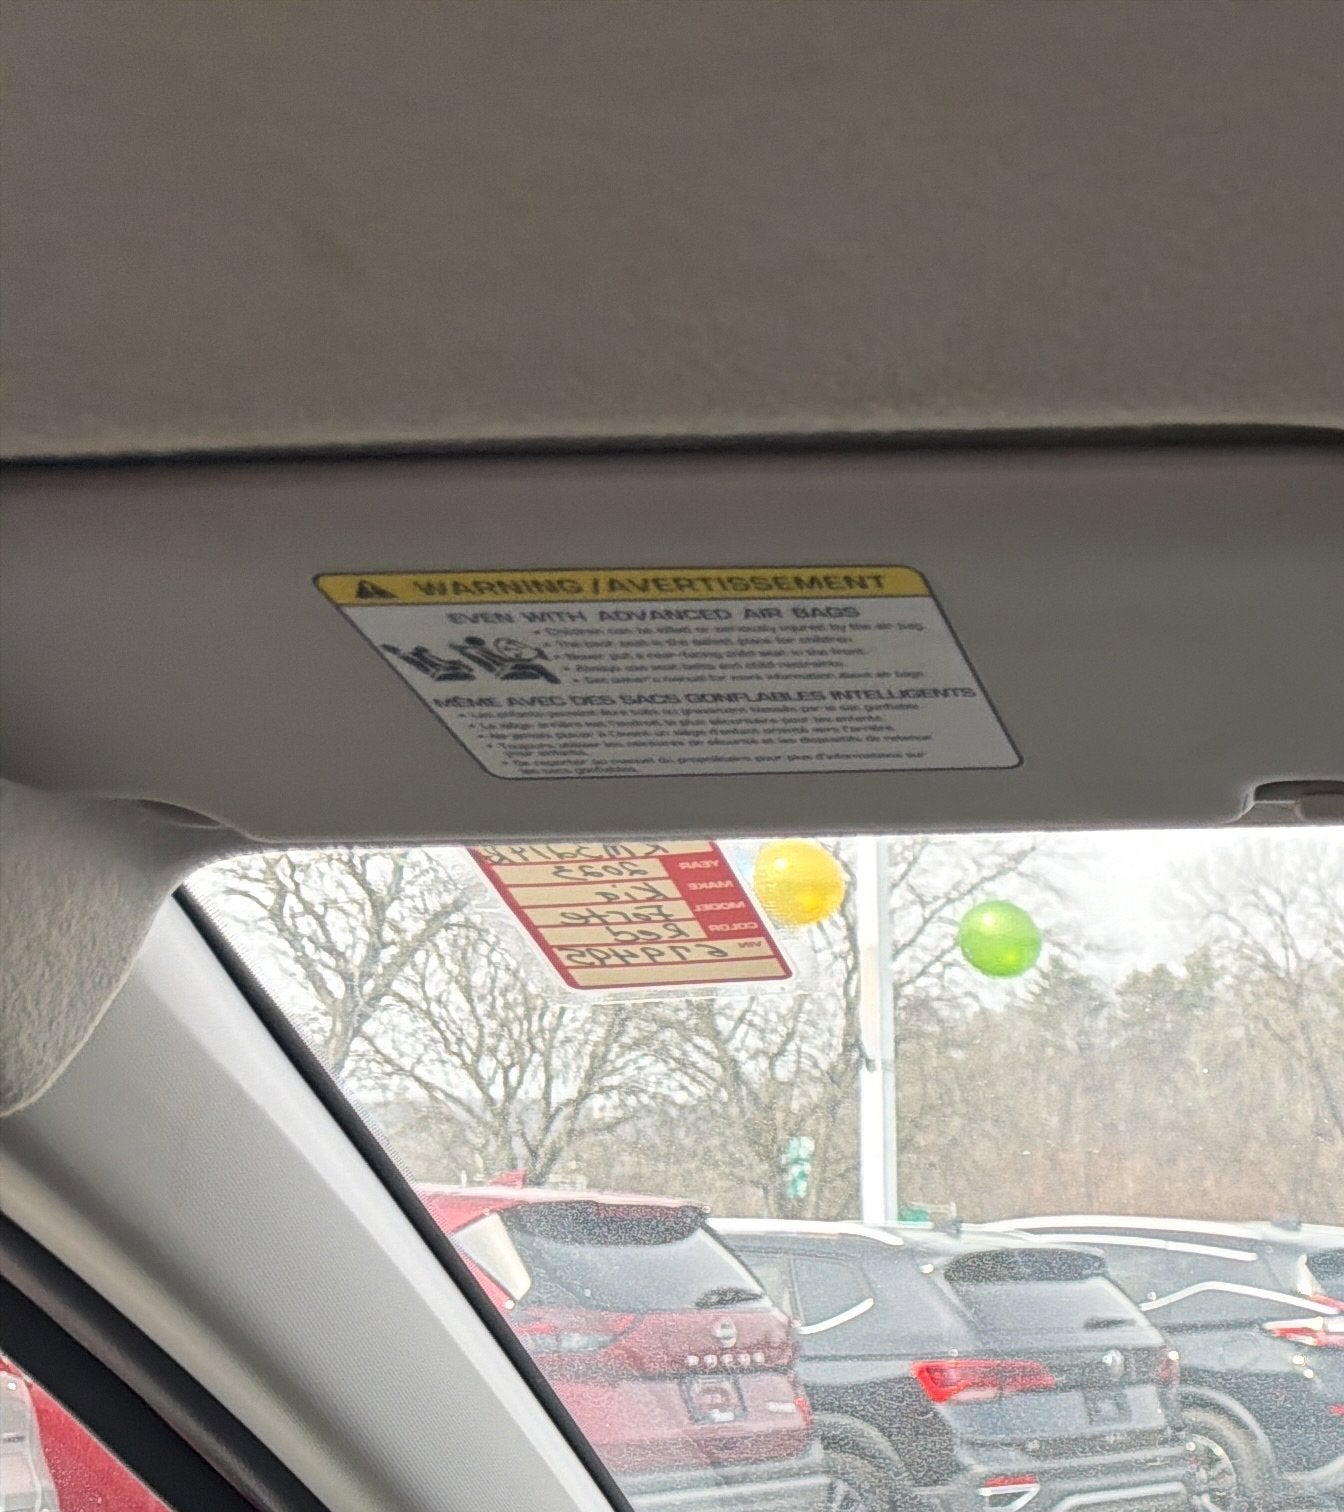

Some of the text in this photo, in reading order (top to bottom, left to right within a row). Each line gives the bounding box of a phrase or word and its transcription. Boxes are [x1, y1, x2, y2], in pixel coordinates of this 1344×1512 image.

[447, 606, 860, 624] EVEN WITH ADVANCED AIR BAGS
[432, 687, 977, 708] MÊME AVEC DES SACS GONFLABLES INTELLIGENTS
